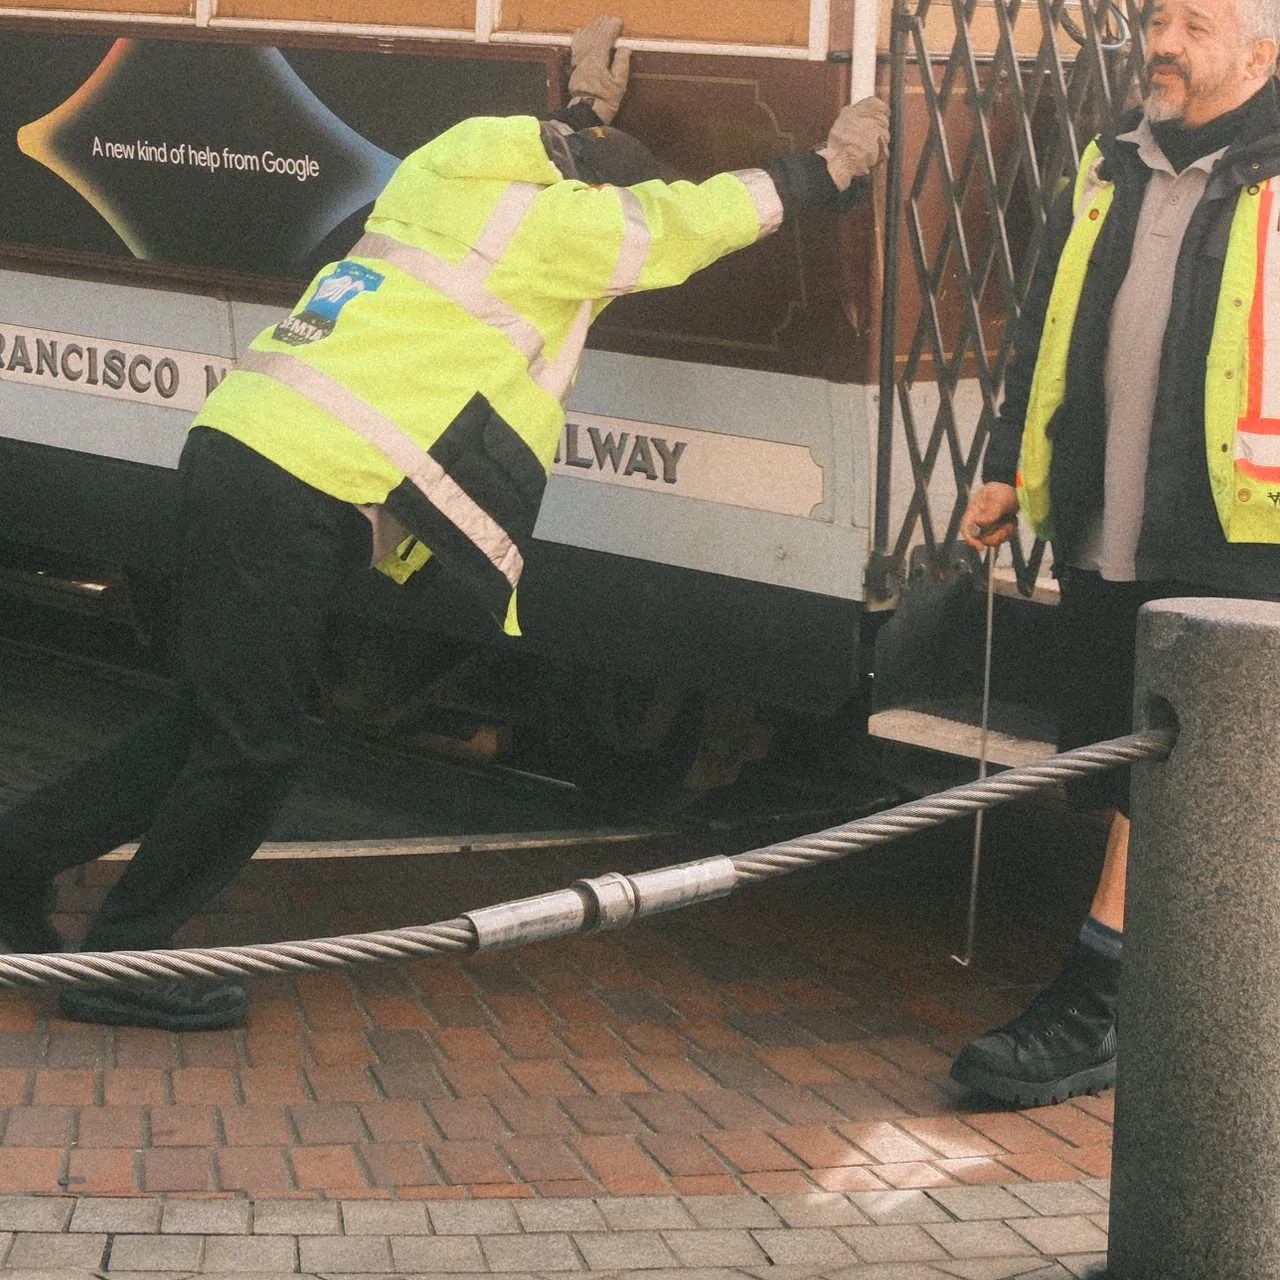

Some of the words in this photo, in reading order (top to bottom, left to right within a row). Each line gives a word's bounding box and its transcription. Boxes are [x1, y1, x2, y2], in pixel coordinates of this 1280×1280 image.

[92, 136, 104, 157] A
[106, 141, 135, 160] new
[137, 140, 167, 163] kind
[170, 143, 187, 165] of
[189, 144, 220, 173] help
[223, 148, 260, 171] from
[262, 150, 320, 182] Google
